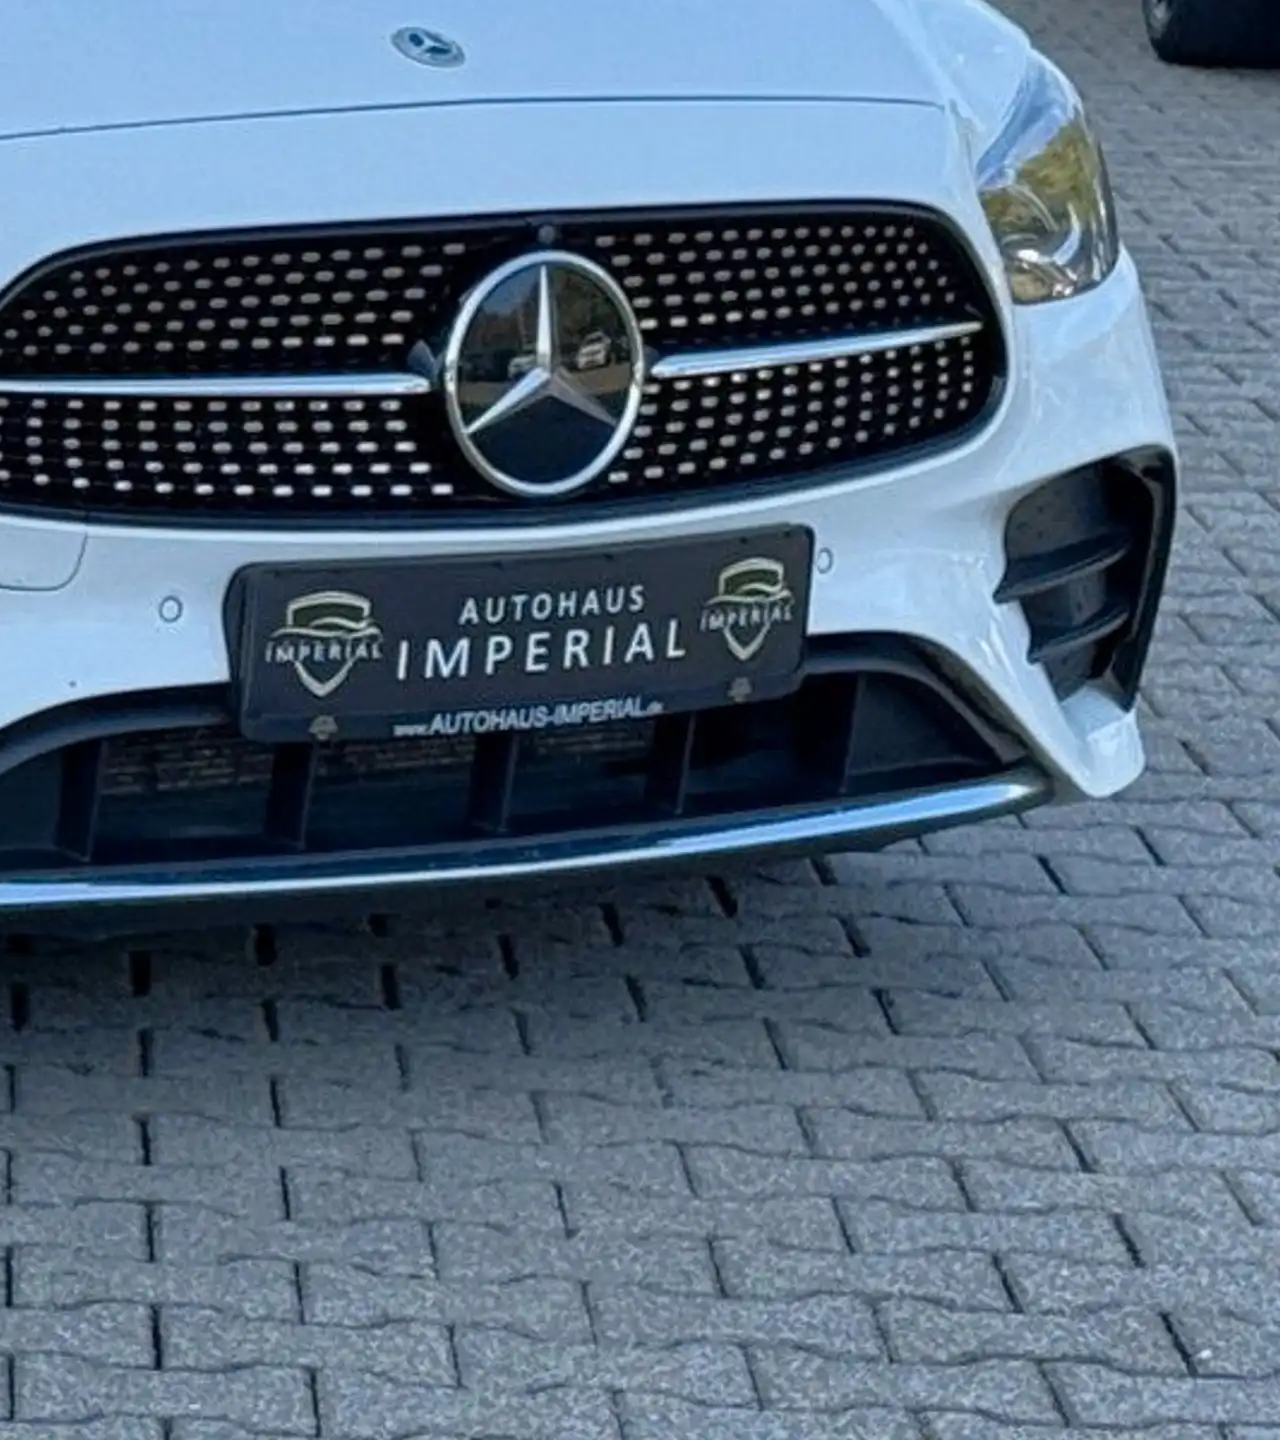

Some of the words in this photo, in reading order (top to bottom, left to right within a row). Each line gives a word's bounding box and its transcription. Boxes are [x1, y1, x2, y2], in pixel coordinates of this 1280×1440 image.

[458, 585, 645, 627] AUTOHAUS
[700, 600, 794, 633] IMPERIAL
[264, 636, 384, 665] IMPERIAL
[394, 619, 687, 682] IMPERIAL
